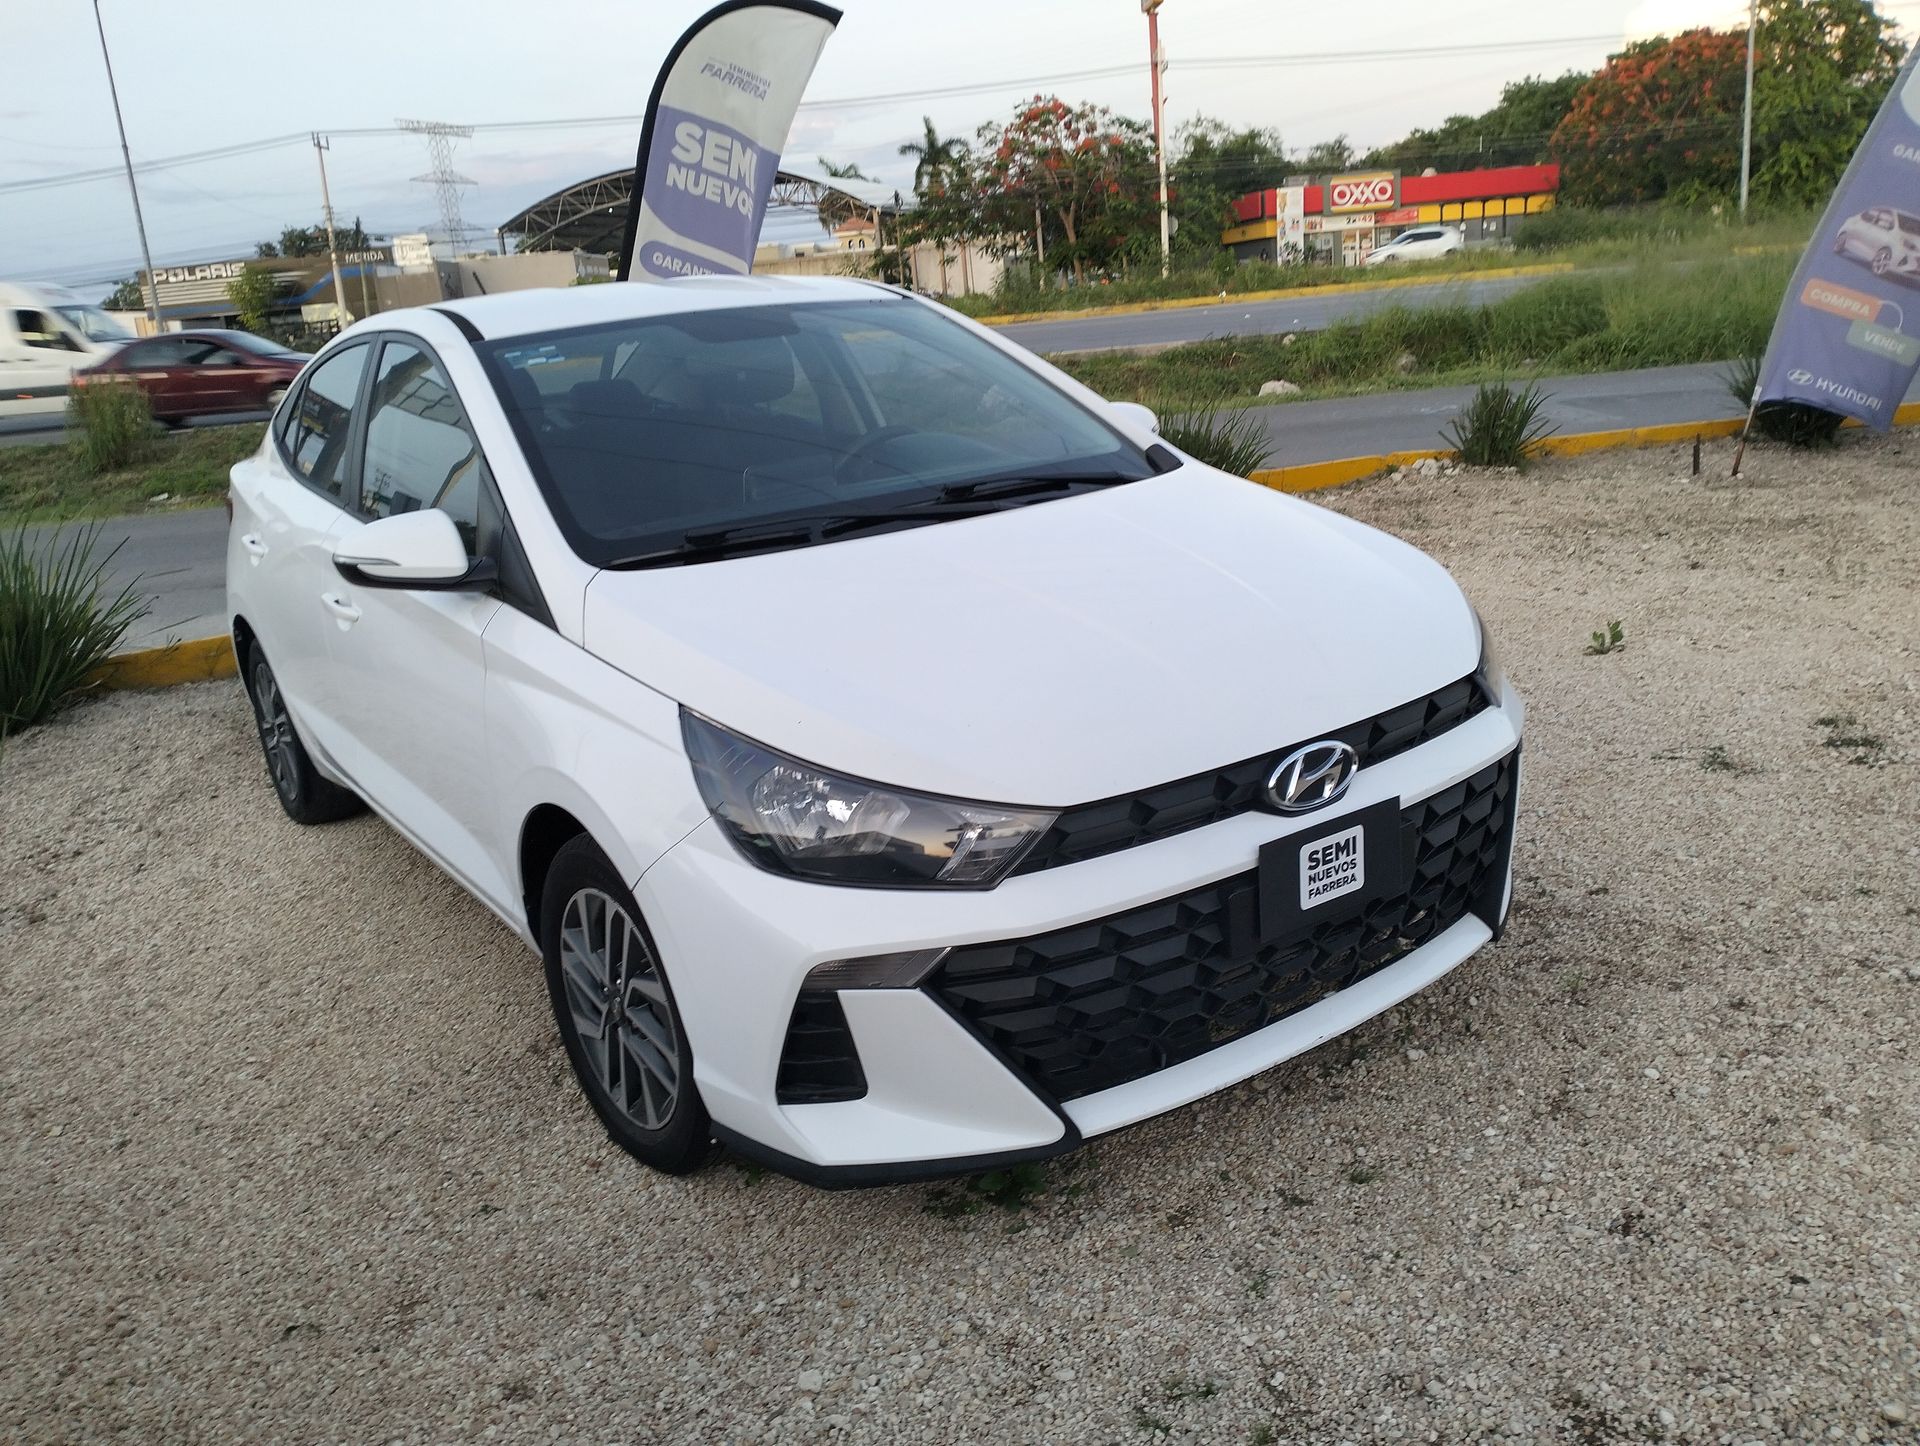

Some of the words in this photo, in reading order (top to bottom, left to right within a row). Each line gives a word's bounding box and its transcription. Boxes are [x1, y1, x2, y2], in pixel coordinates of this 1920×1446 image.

[671, 120, 757, 195] SEMI
[1333, 178, 1393, 207] OXXO
[152, 261, 246, 284] POLARIS
[652, 252, 717, 277] GARAN
[1810, 289, 1871, 317] COMPRA
[1864, 331, 1906, 355] VENDE
[1815, 377, 1883, 411] HYUNDAI
[1307, 835, 1357, 870] SEMI
[1308, 858, 1357, 886] NUEVOS
[1308, 873, 1357, 900] FARRERA
